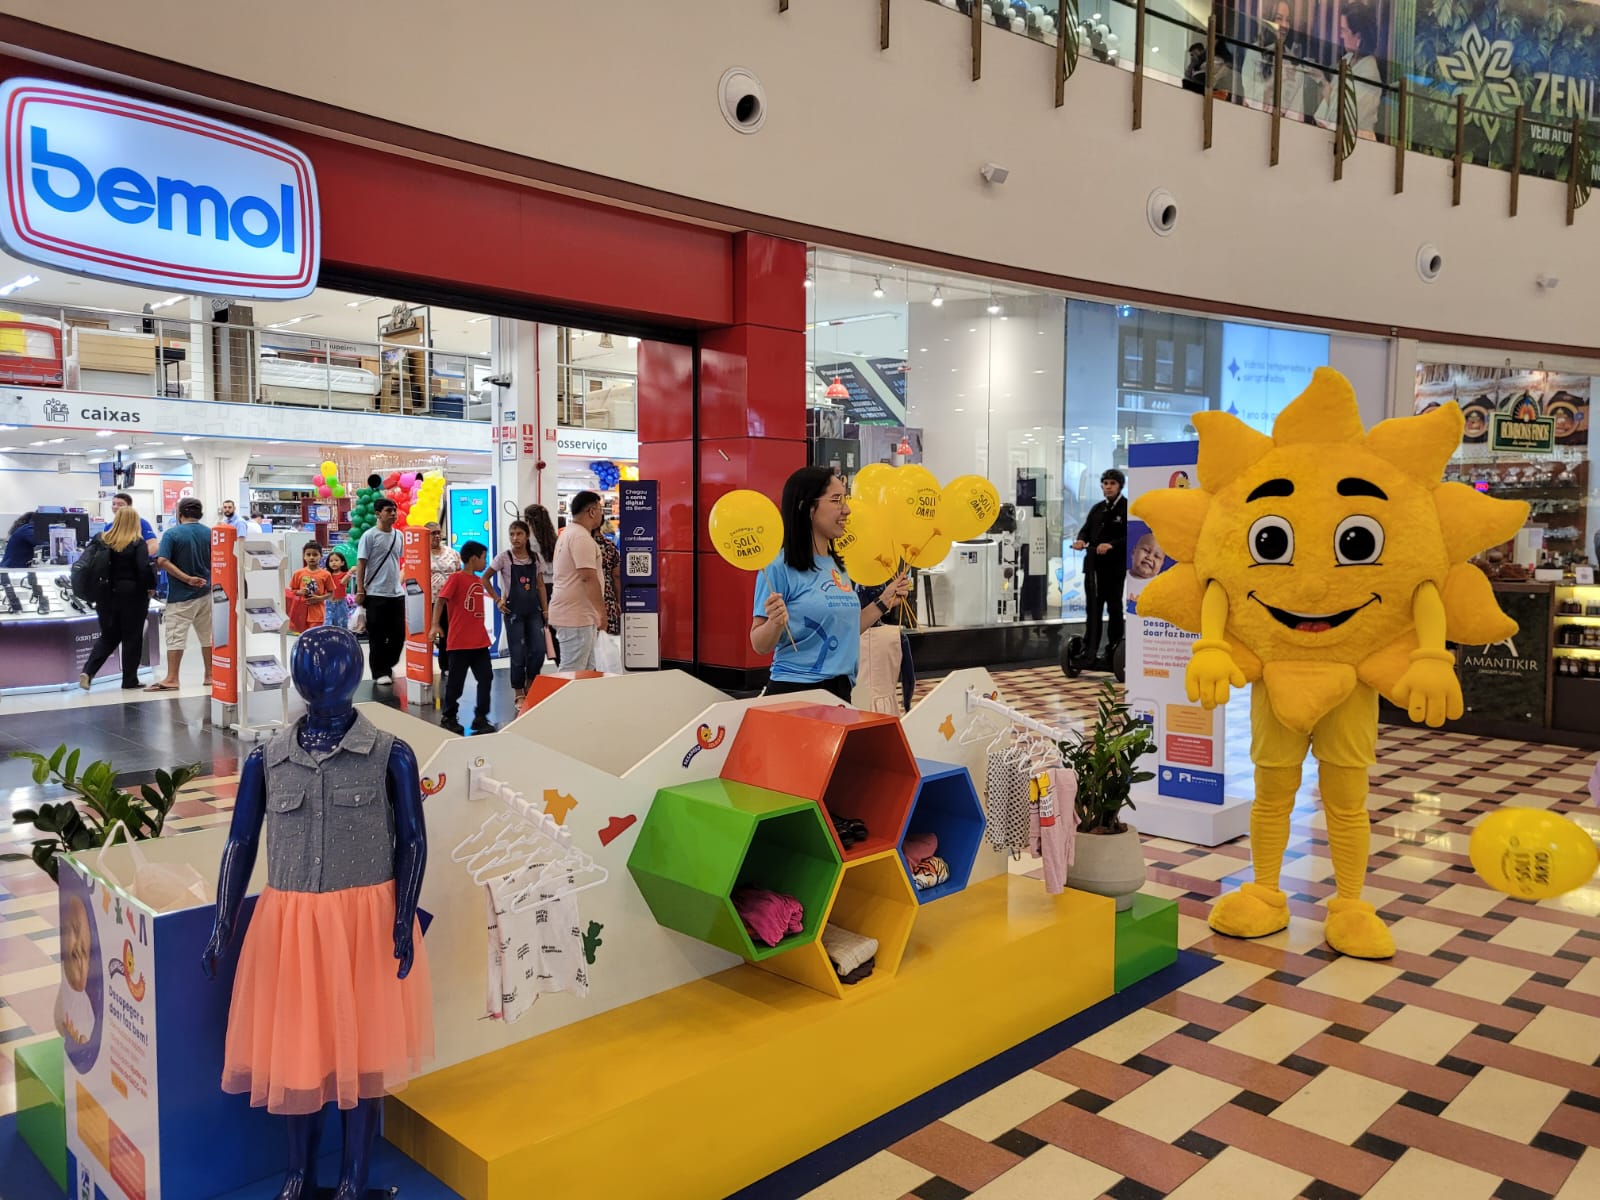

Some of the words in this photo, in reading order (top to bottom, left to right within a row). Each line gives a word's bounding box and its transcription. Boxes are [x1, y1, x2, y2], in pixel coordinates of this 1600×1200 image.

[1531, 124, 1551, 141] VEM
[31, 125, 295, 254] bemol
[81, 406, 141, 423] caixas
[918, 497, 937, 507] SOLI
[978, 494, 993, 513] SOLI
[733, 534, 757, 549] SOLI
[1143, 628, 1163, 638] doar
[1165, 630, 1178, 638] faz
[1464, 655, 1538, 671] AMANTIKIR
